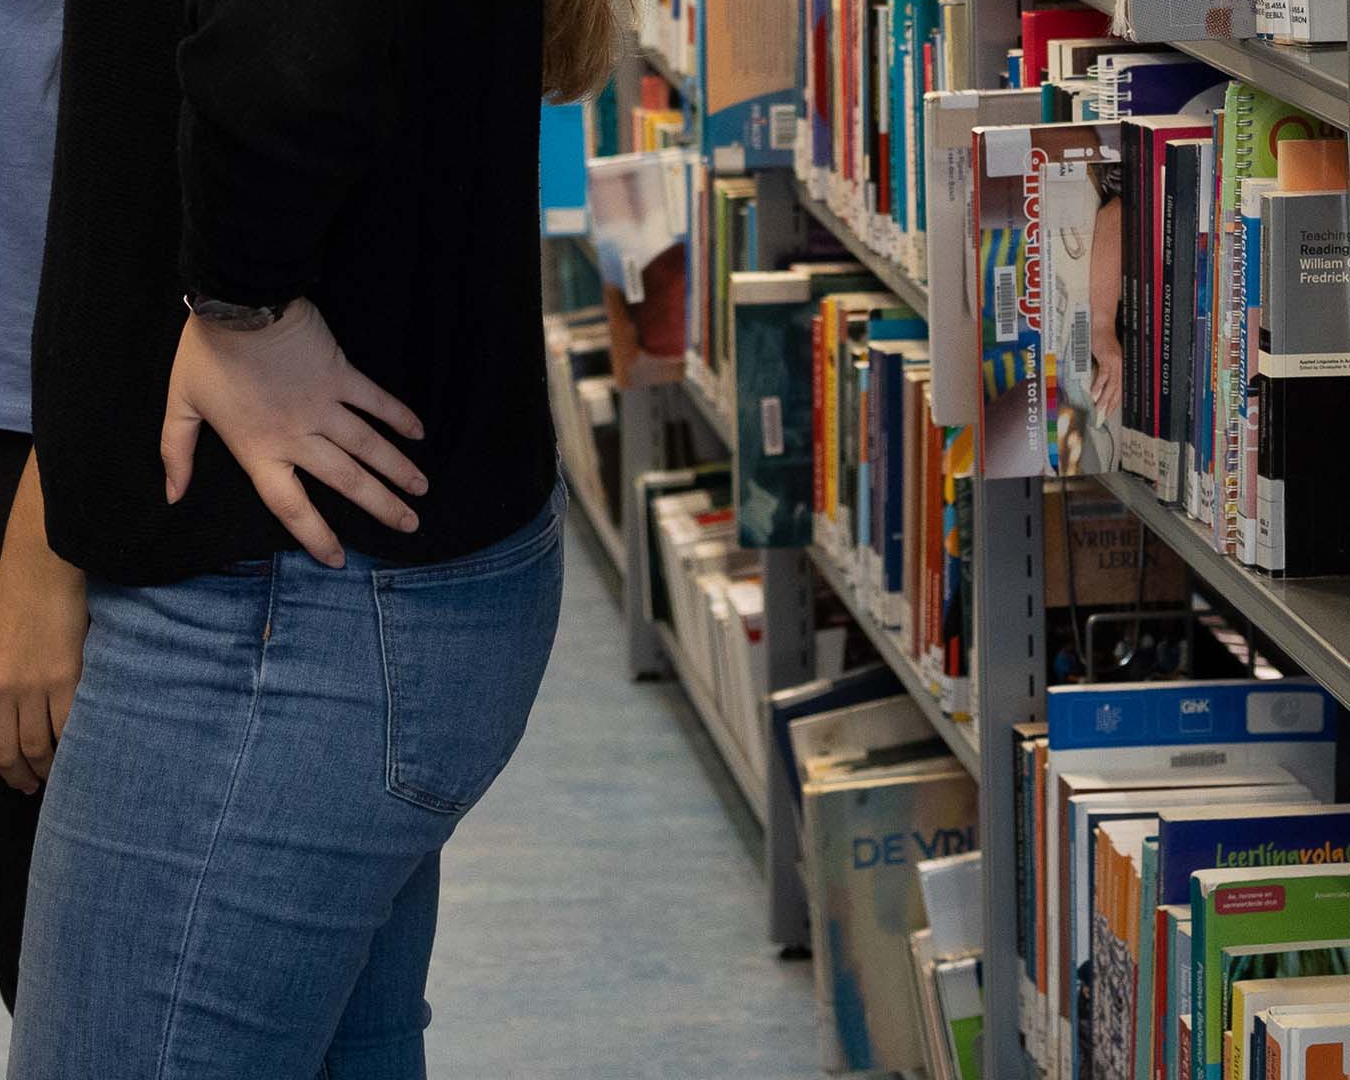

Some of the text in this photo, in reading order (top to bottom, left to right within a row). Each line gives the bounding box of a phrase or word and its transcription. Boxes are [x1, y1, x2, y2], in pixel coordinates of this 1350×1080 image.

[1300, 244, 1349, 256] Reading
[1299, 258, 1342, 270] William
[1300, 272, 1349, 283] Fredrick
[1239, 223, 1248, 408] Motivating Learning
[1162, 284, 1171, 395] ONTROEREND GOED
[1026, 344, 1036, 367] van
[1027, 382, 1037, 403] tot
[1028, 407, 1037, 423] 20
[852, 833, 906, 869] DE
